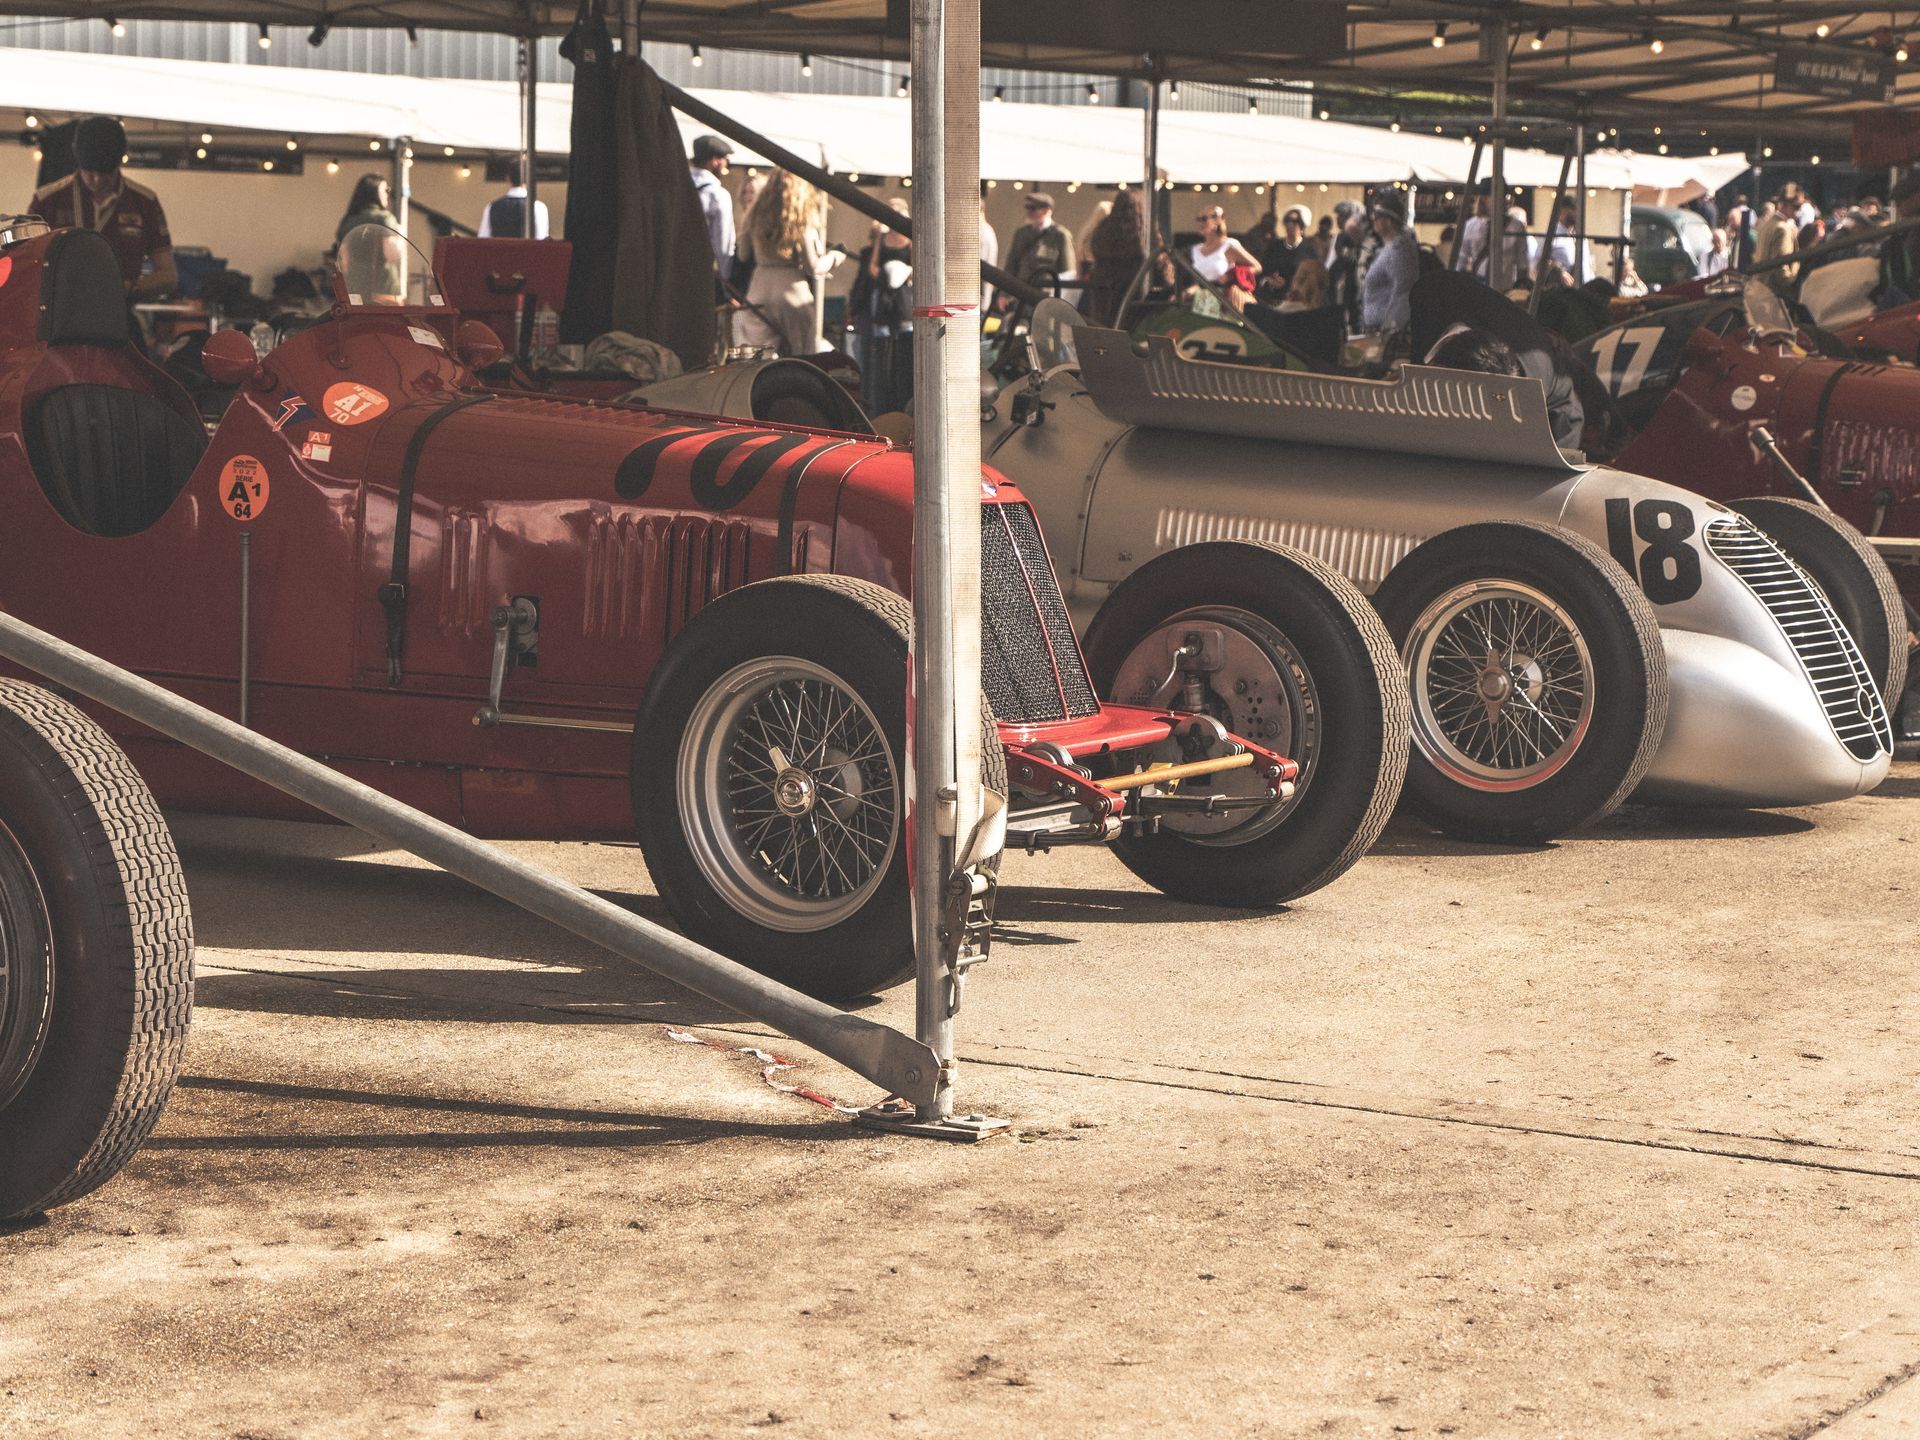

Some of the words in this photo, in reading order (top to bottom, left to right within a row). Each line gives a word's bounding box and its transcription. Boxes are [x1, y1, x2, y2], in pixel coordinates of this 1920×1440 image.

[1591, 326, 1666, 398] 17
[329, 408, 350, 424] 70
[334, 394, 372, 416] A1
[614, 417, 811, 511] 70
[234, 502, 251, 518] 64
[1605, 497, 1703, 605] 18
